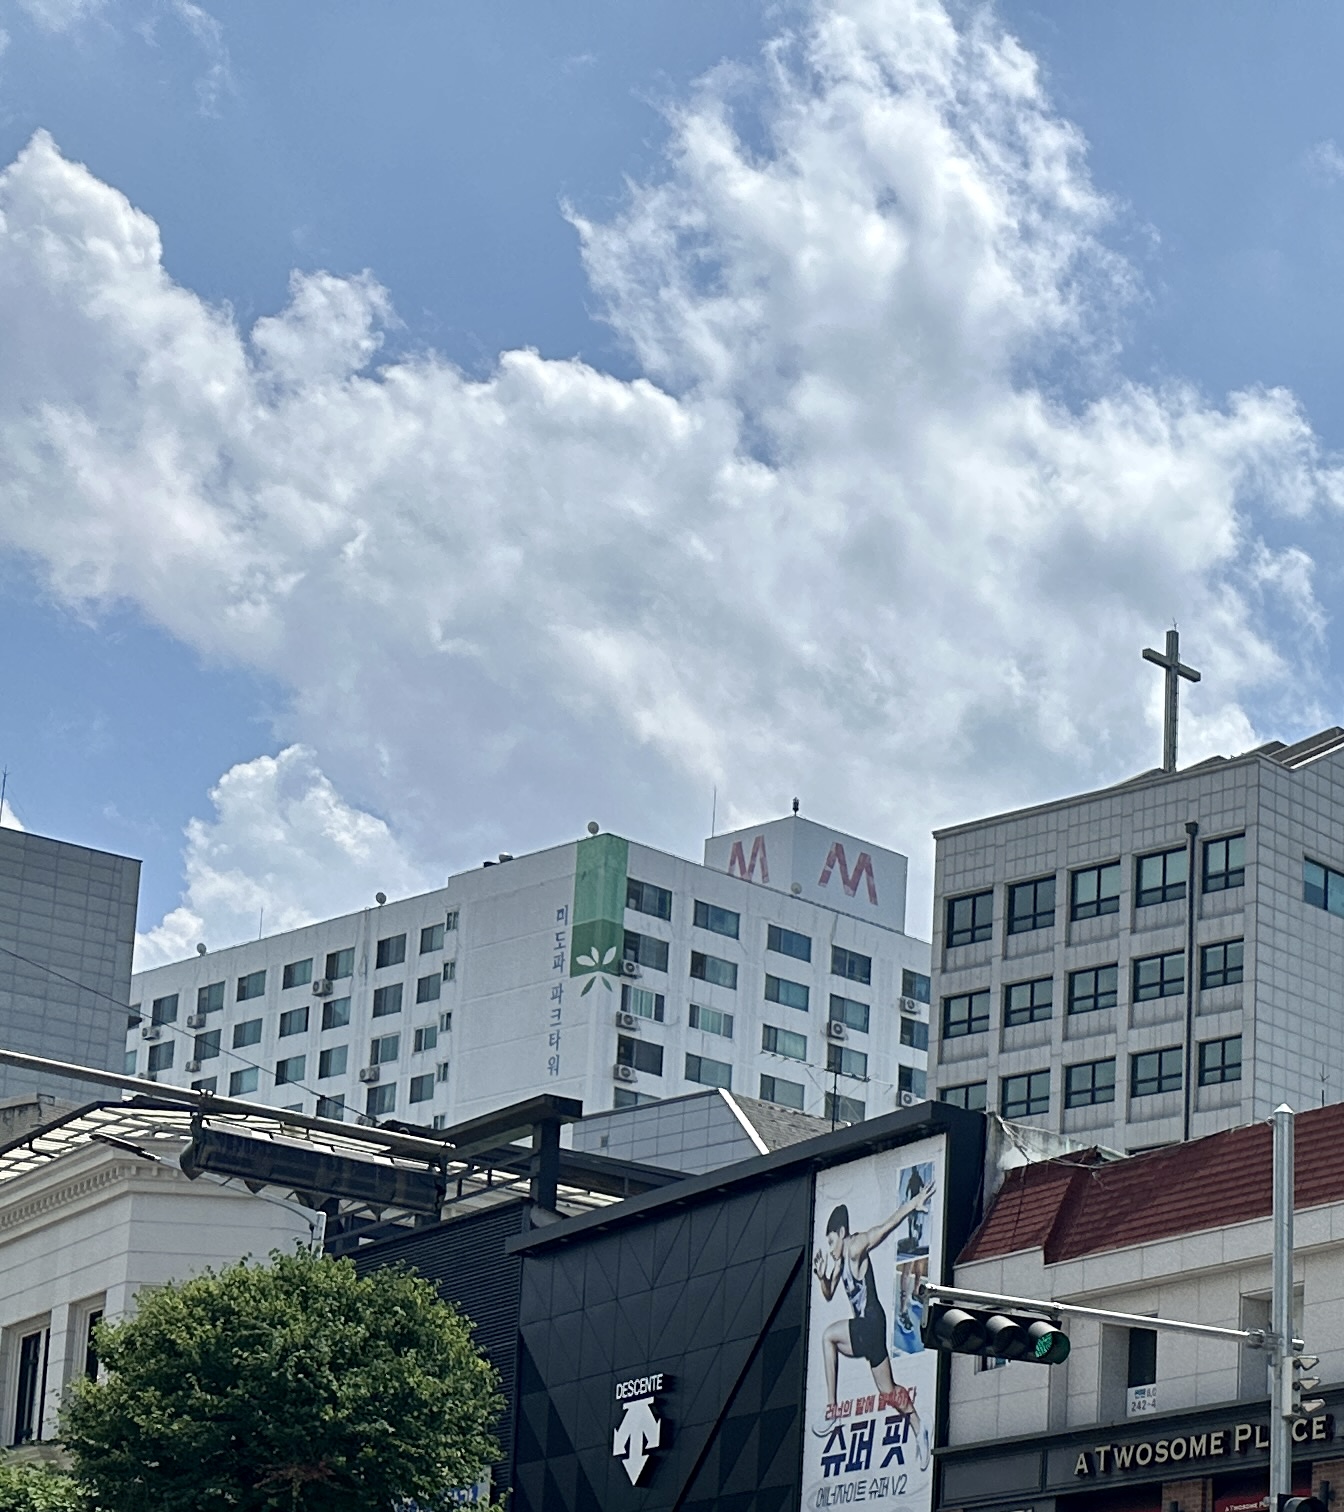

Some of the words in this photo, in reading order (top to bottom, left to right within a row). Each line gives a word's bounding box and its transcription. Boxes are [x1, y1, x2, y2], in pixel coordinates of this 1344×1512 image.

[818, 842, 879, 906] M
[552, 904, 569, 975] 미도파
[547, 982, 563, 1077] 파크타워
[616, 1373, 664, 1399] DESCENTE
[820, 1419, 876, 1478] 슈퍼
[1074, 1453, 1089, 1475] A
[1095, 1430, 1224, 1473] TWOSOME
[1234, 1415, 1327, 1451] PLCE
[868, 1477, 889, 1500] 슈퍼
[891, 1474, 908, 1496] V2
